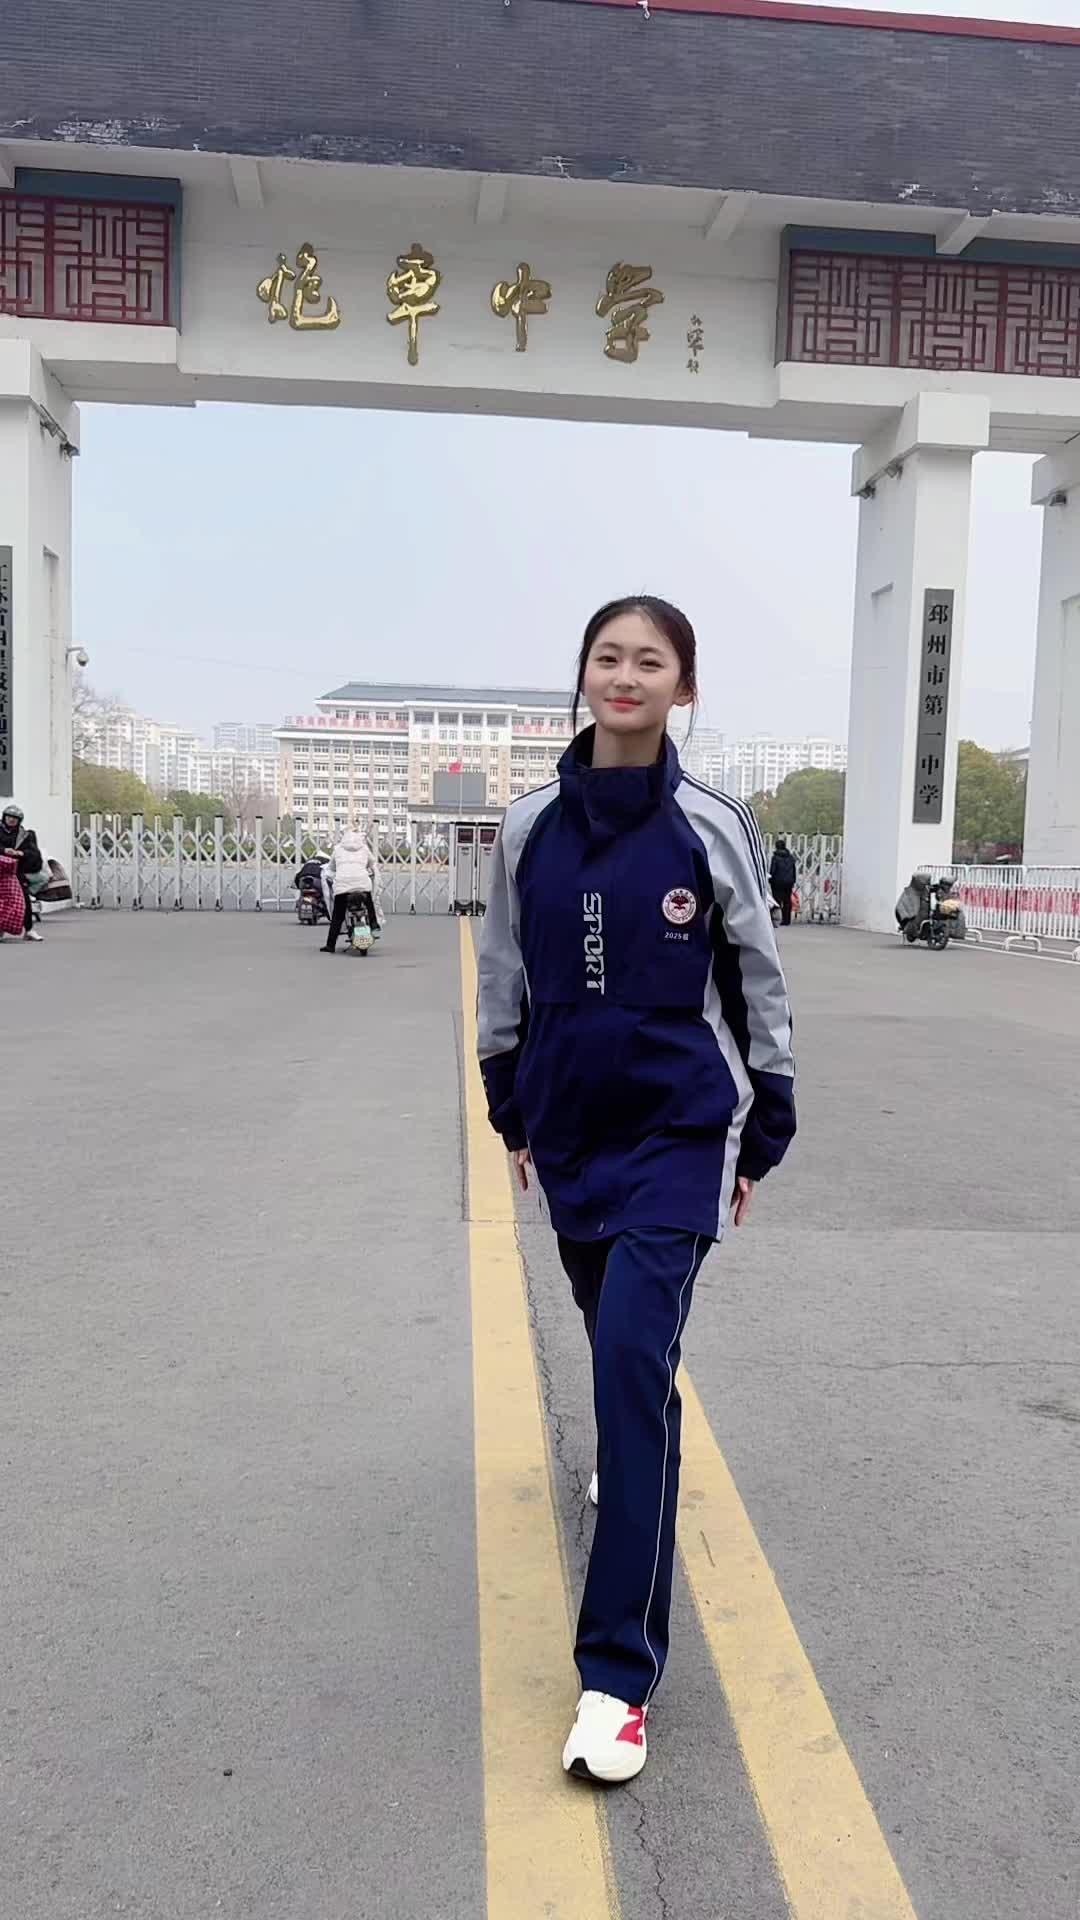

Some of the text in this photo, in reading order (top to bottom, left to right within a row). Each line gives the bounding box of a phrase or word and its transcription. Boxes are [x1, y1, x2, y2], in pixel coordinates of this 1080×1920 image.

[919, 604, 949, 805] 邳州市第一中学
[583, 892, 605, 995] SPORT
